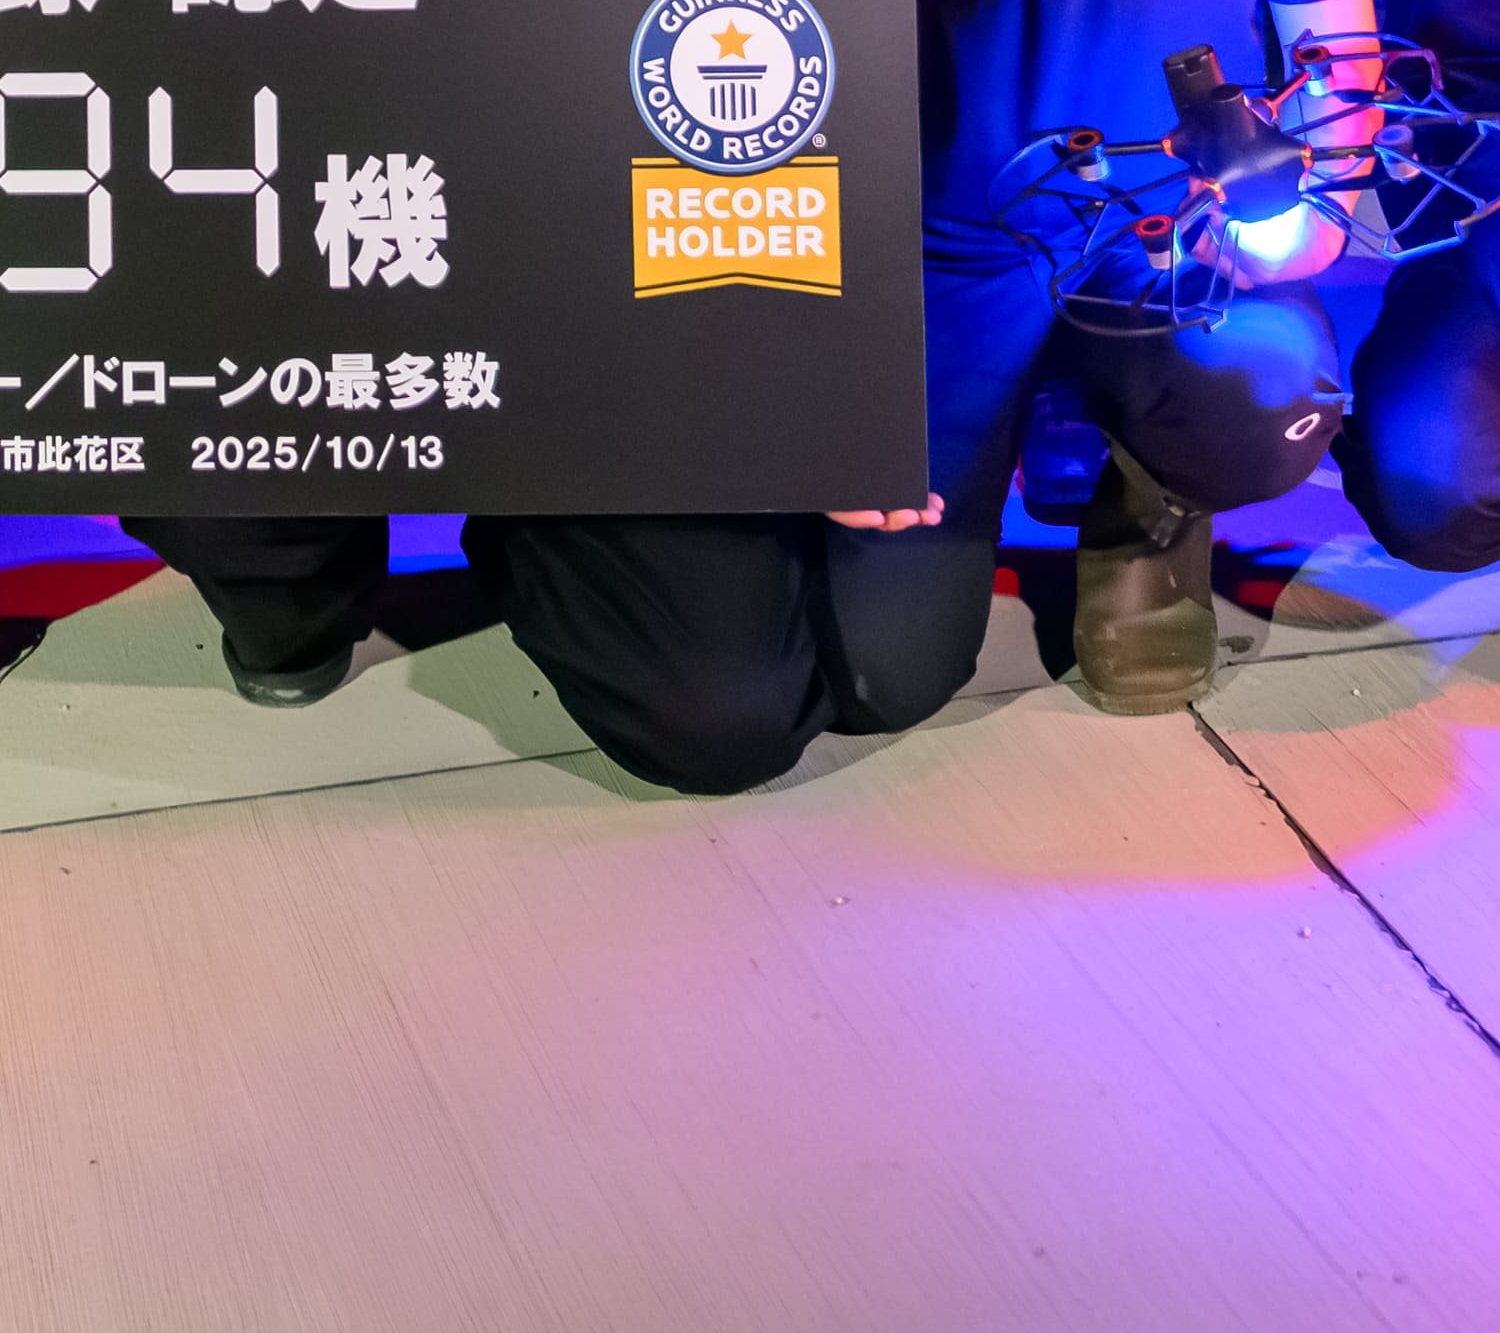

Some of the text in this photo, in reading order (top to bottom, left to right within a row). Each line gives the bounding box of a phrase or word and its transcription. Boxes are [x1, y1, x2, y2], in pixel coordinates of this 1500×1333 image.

[642, 56, 713, 153] WORLD
[721, 54, 823, 161] RECORDS
[646, 187, 827, 220] RECORD
[647, 225, 826, 258] HOLDER
[191, 434, 445, 473] 2025/10/13
